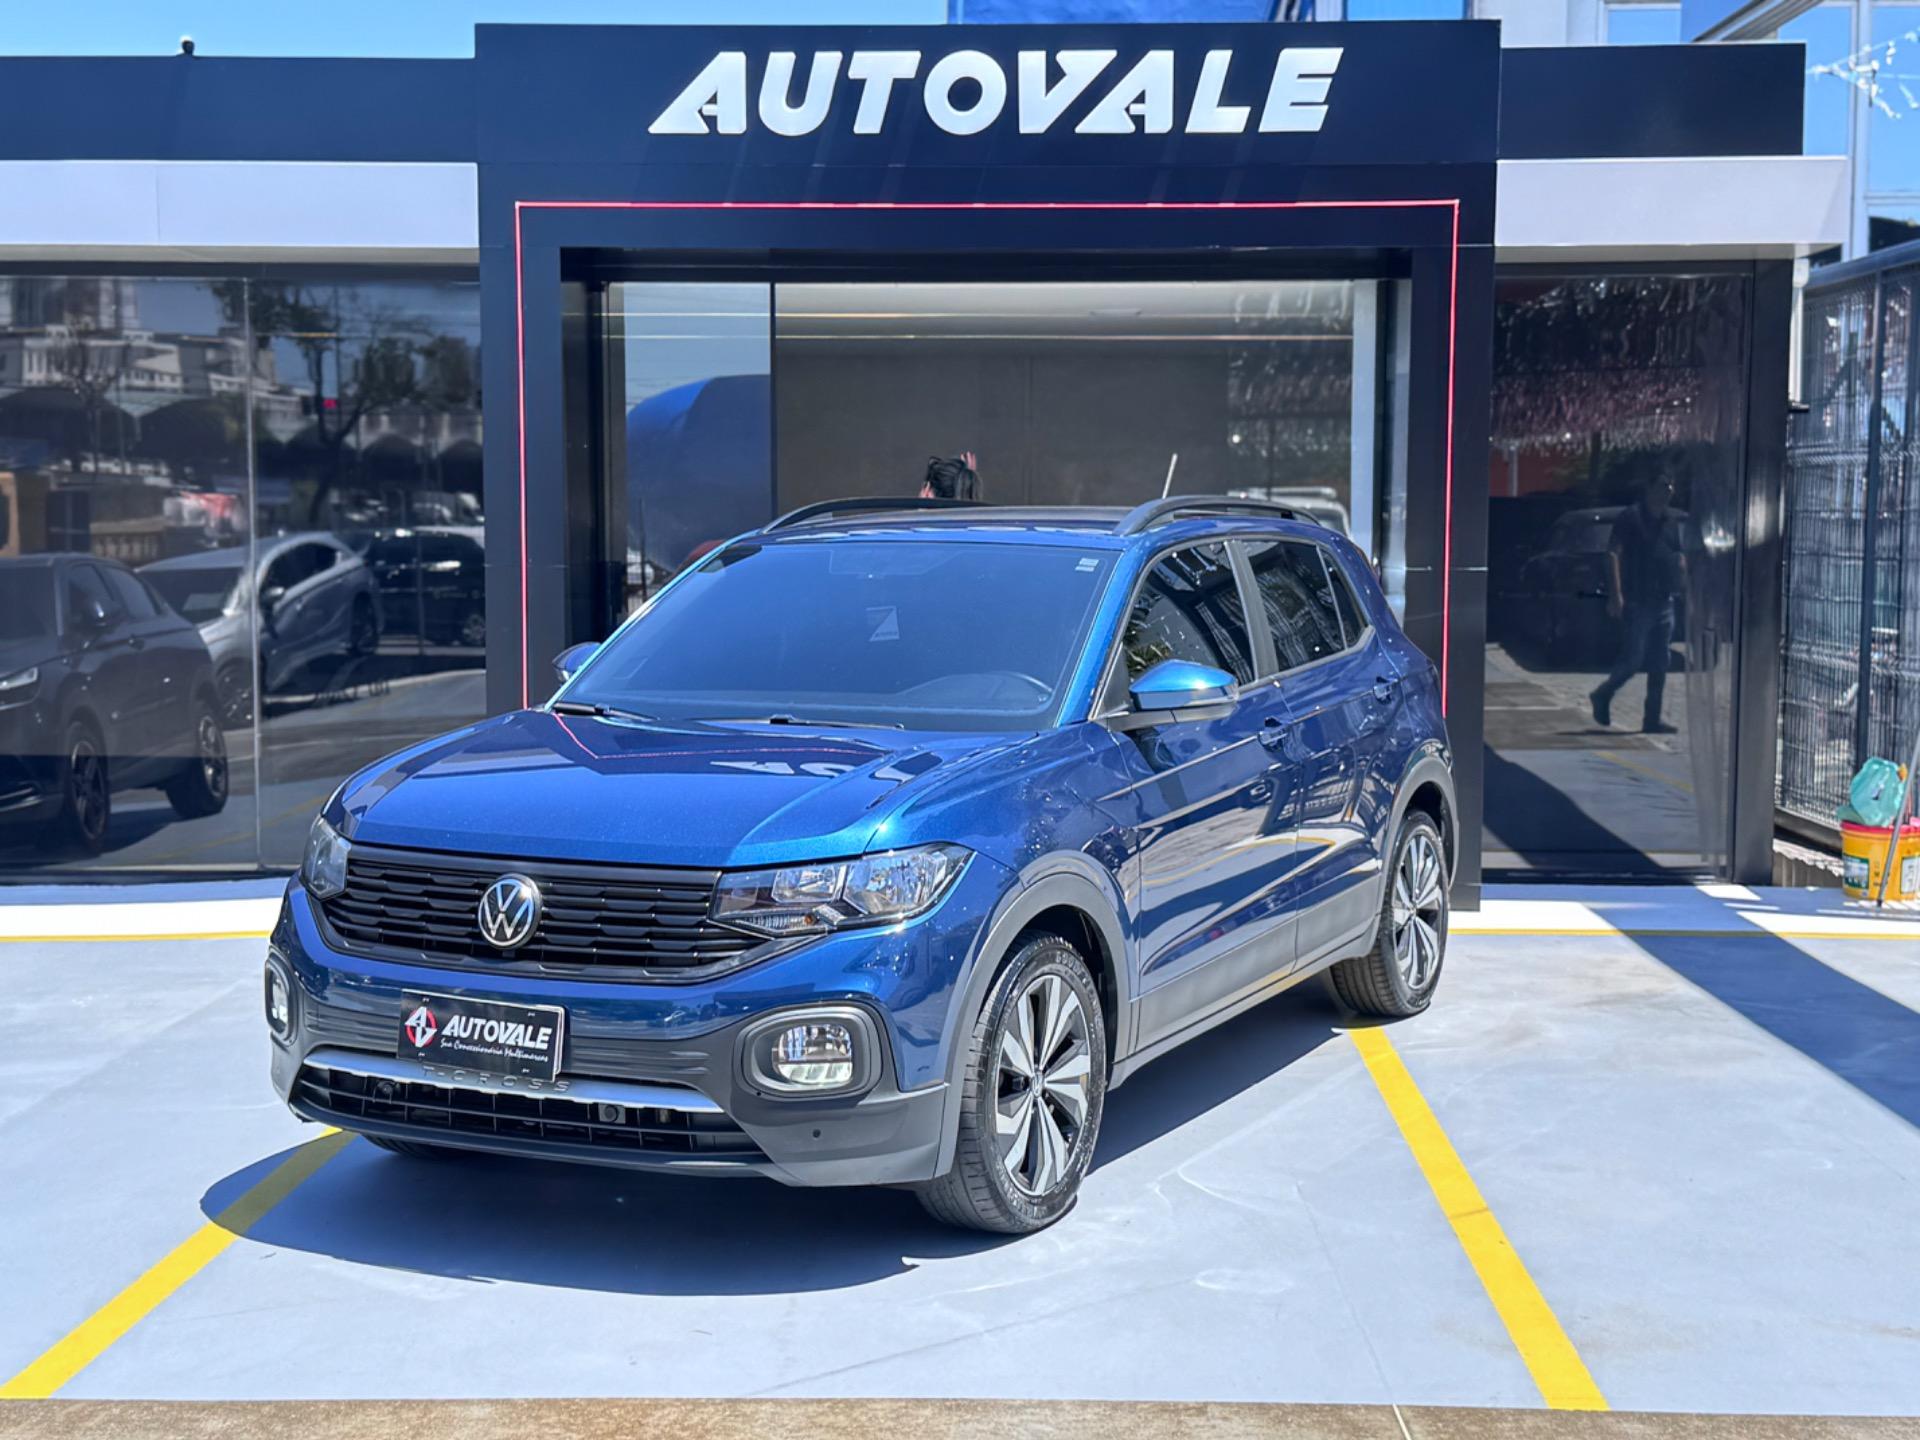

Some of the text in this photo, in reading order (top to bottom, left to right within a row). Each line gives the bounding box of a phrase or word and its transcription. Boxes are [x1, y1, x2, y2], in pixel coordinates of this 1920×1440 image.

[648, 47, 1344, 136] AUTOVALE
[441, 1015, 552, 1049] AUTOVALE
[423, 1066, 570, 1092] T-CROSS
